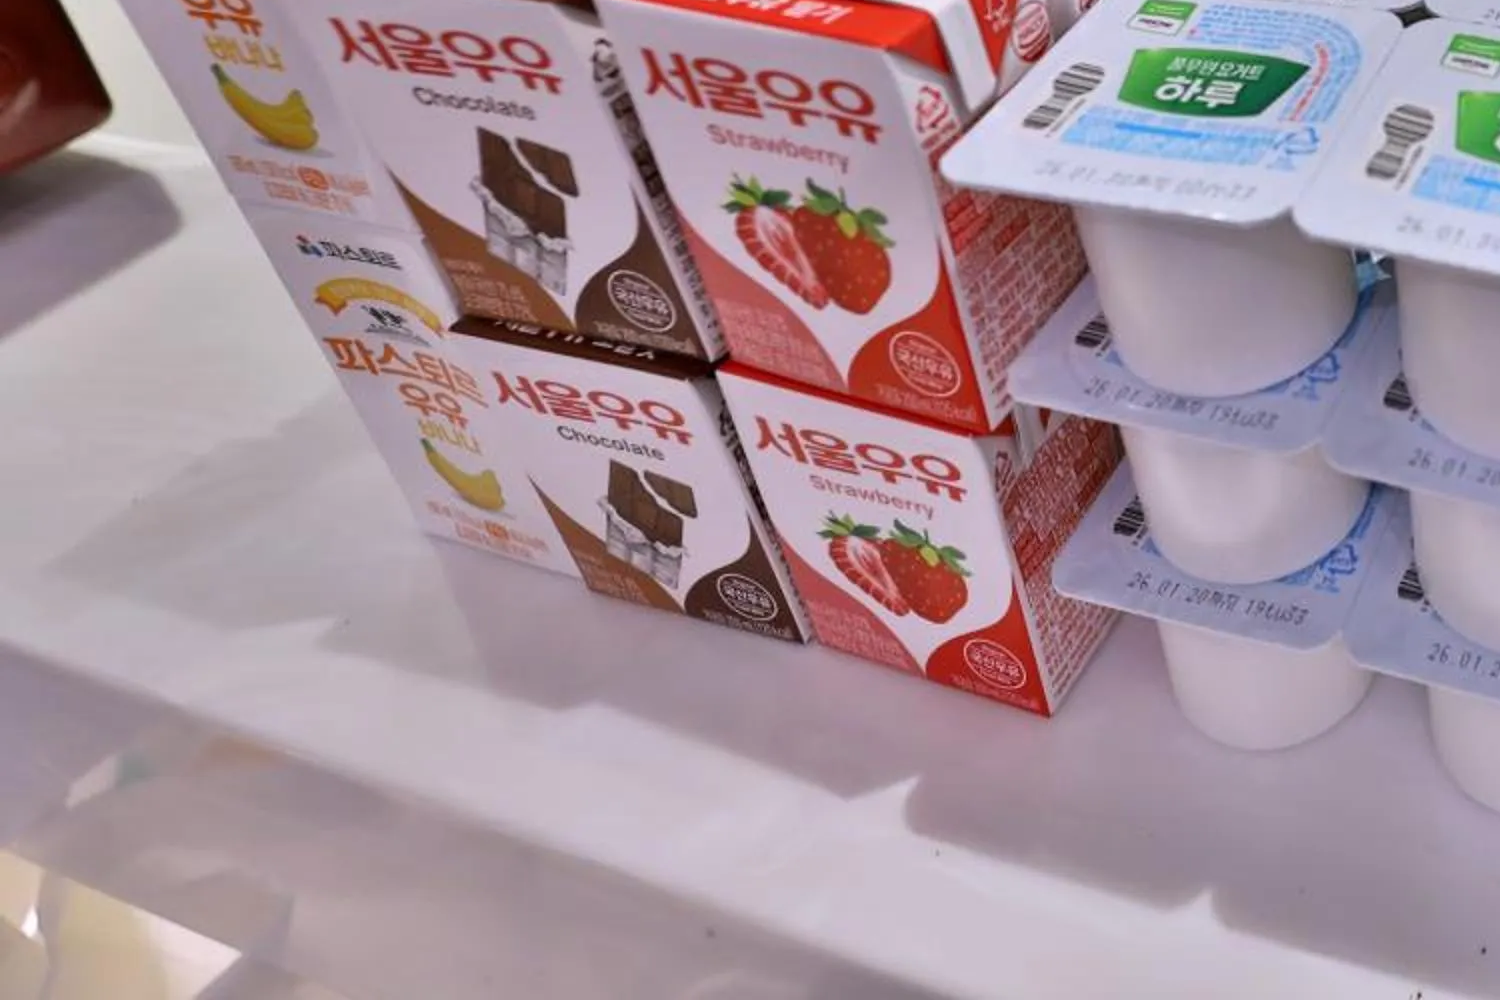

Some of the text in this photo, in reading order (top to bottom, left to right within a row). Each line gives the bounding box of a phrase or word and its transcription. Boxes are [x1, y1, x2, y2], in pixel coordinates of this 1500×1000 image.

[327, 16, 563, 94] 서울우유
[411, 85, 538, 121] Chocolate
[640, 47, 885, 145] 서울우유
[1154, 75, 1245, 110] 하루
[705, 123, 850, 174] Strawberry
[322, 336, 490, 409] 파스퇴르
[399, 381, 470, 429] 우유
[491, 370, 695, 446] 서울우유
[556, 424, 666, 462] Chocolate
[754, 415, 968, 503] 서울우유
[808, 473, 935, 521] Strawberry
